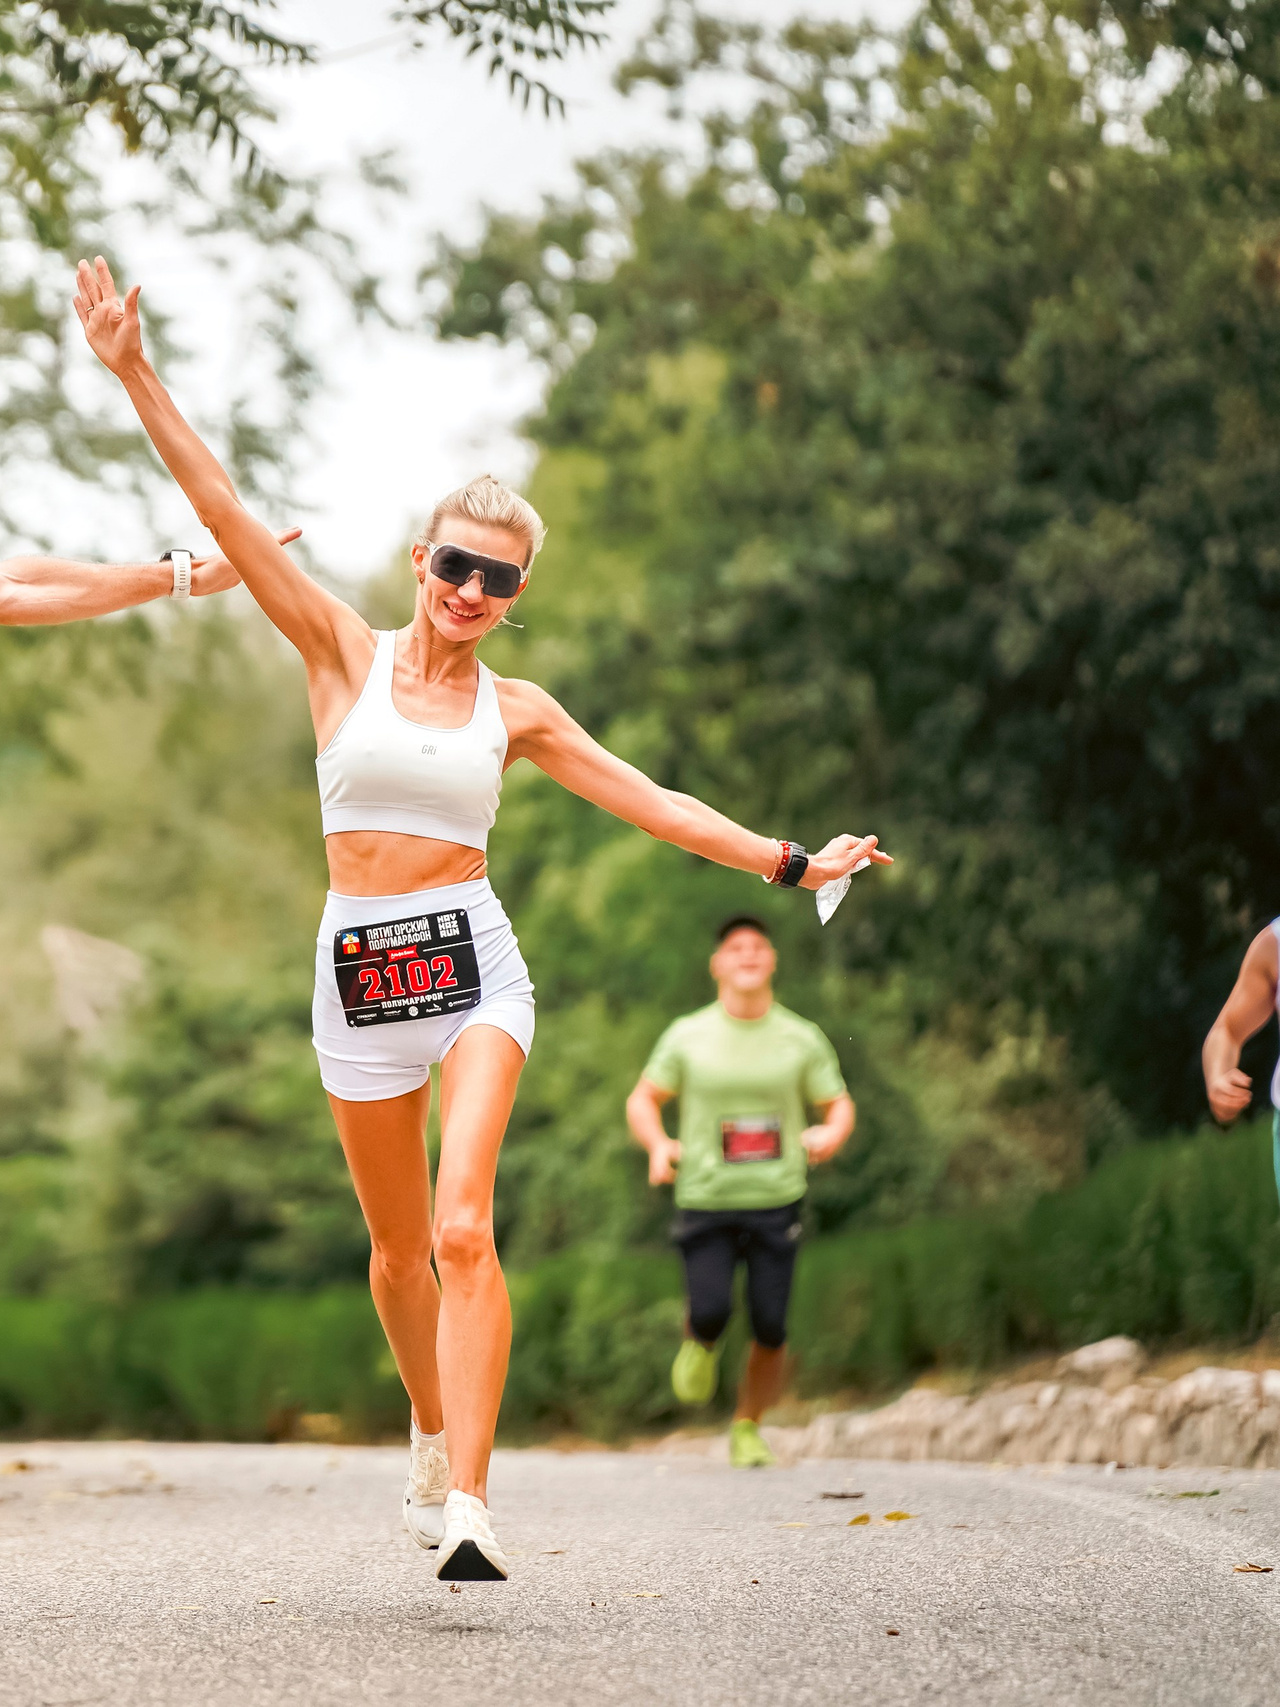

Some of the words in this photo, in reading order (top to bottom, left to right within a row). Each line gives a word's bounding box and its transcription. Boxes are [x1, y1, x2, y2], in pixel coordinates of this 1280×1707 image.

[366, 917, 430, 941] ПЯТИГОРСКИЙ
[440, 927, 460, 938] RUN
[368, 930, 432, 951] ПОЛУМАРАФОН
[358, 955, 458, 1002] 2102
[381, 992, 444, 1009] ПОЛУМАРАФОН
